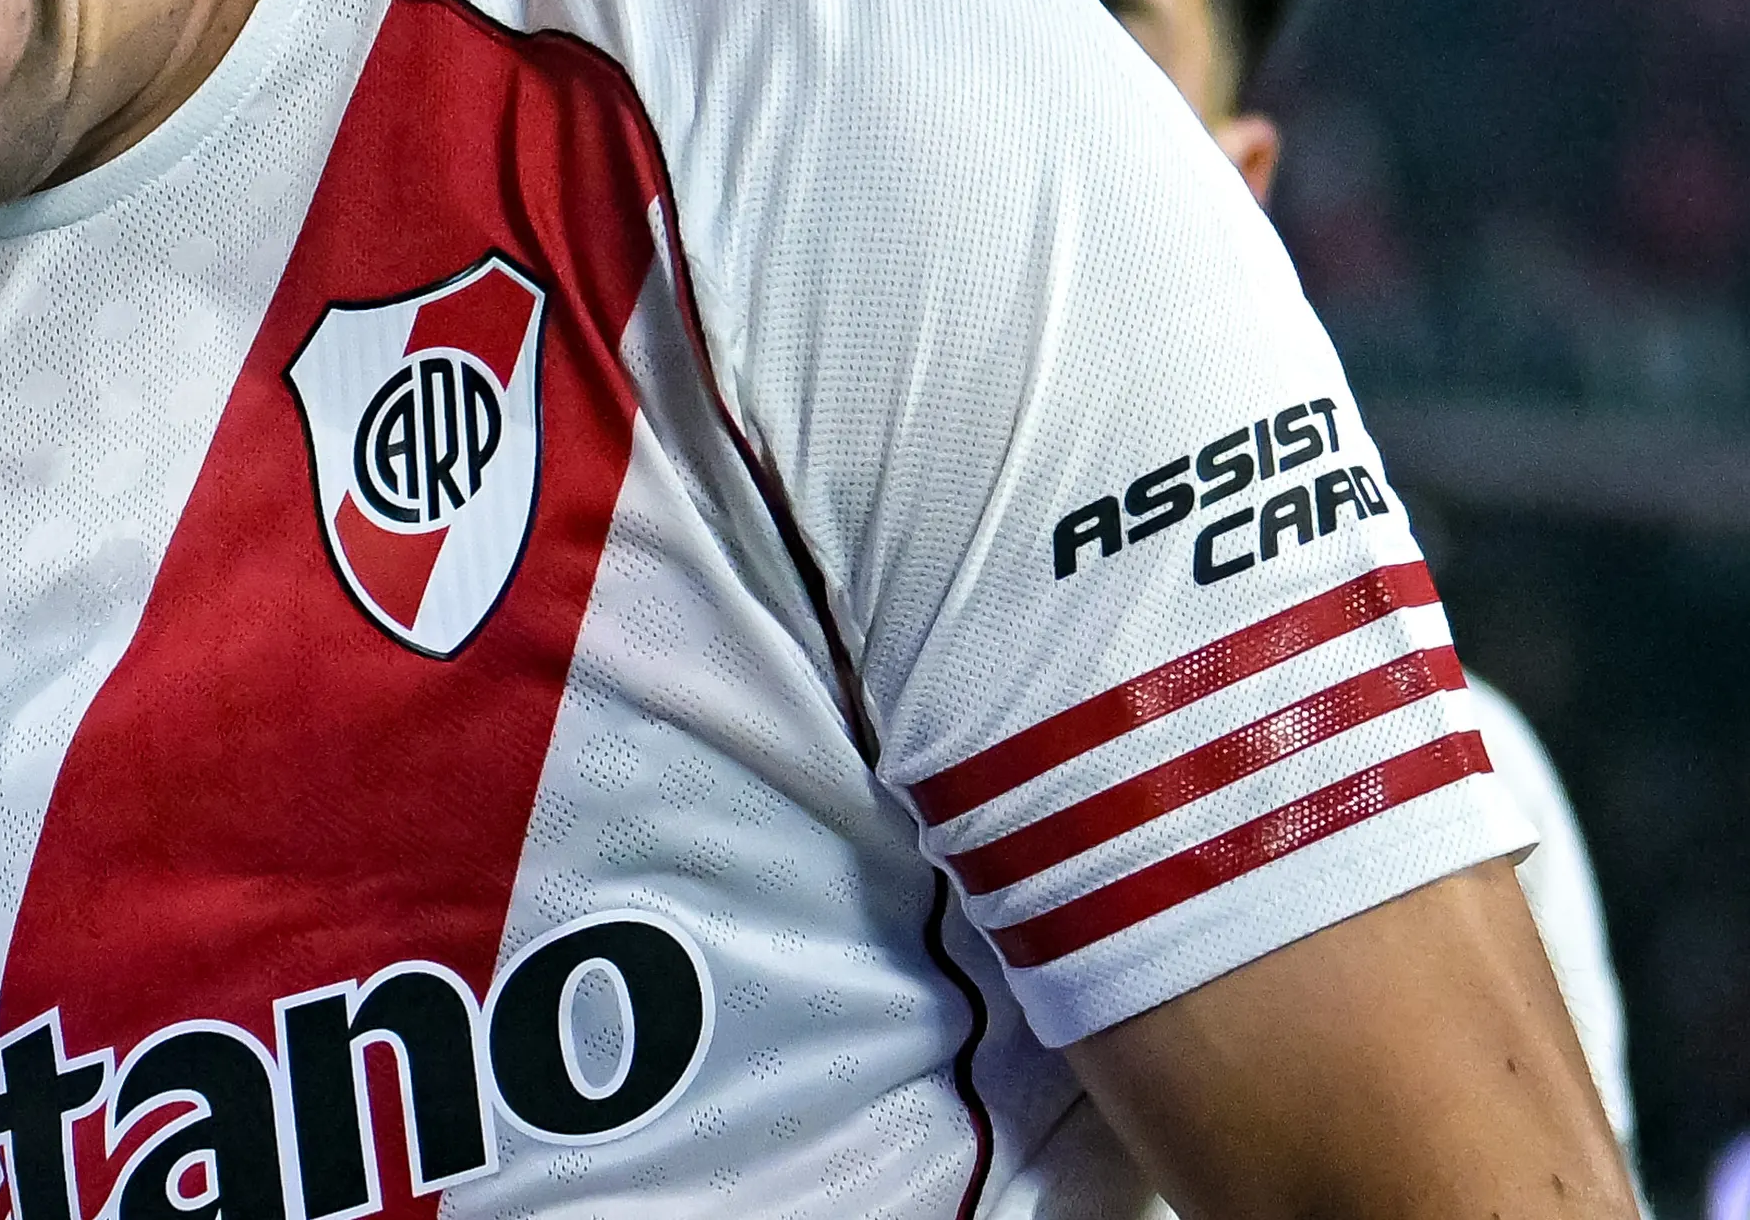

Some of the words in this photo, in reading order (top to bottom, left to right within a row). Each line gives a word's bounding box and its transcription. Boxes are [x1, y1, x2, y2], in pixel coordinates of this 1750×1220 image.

[353, 356, 502, 524] CARP
[1052, 397, 1340, 581] ASSIST
[1192, 465, 1390, 587] CARD
